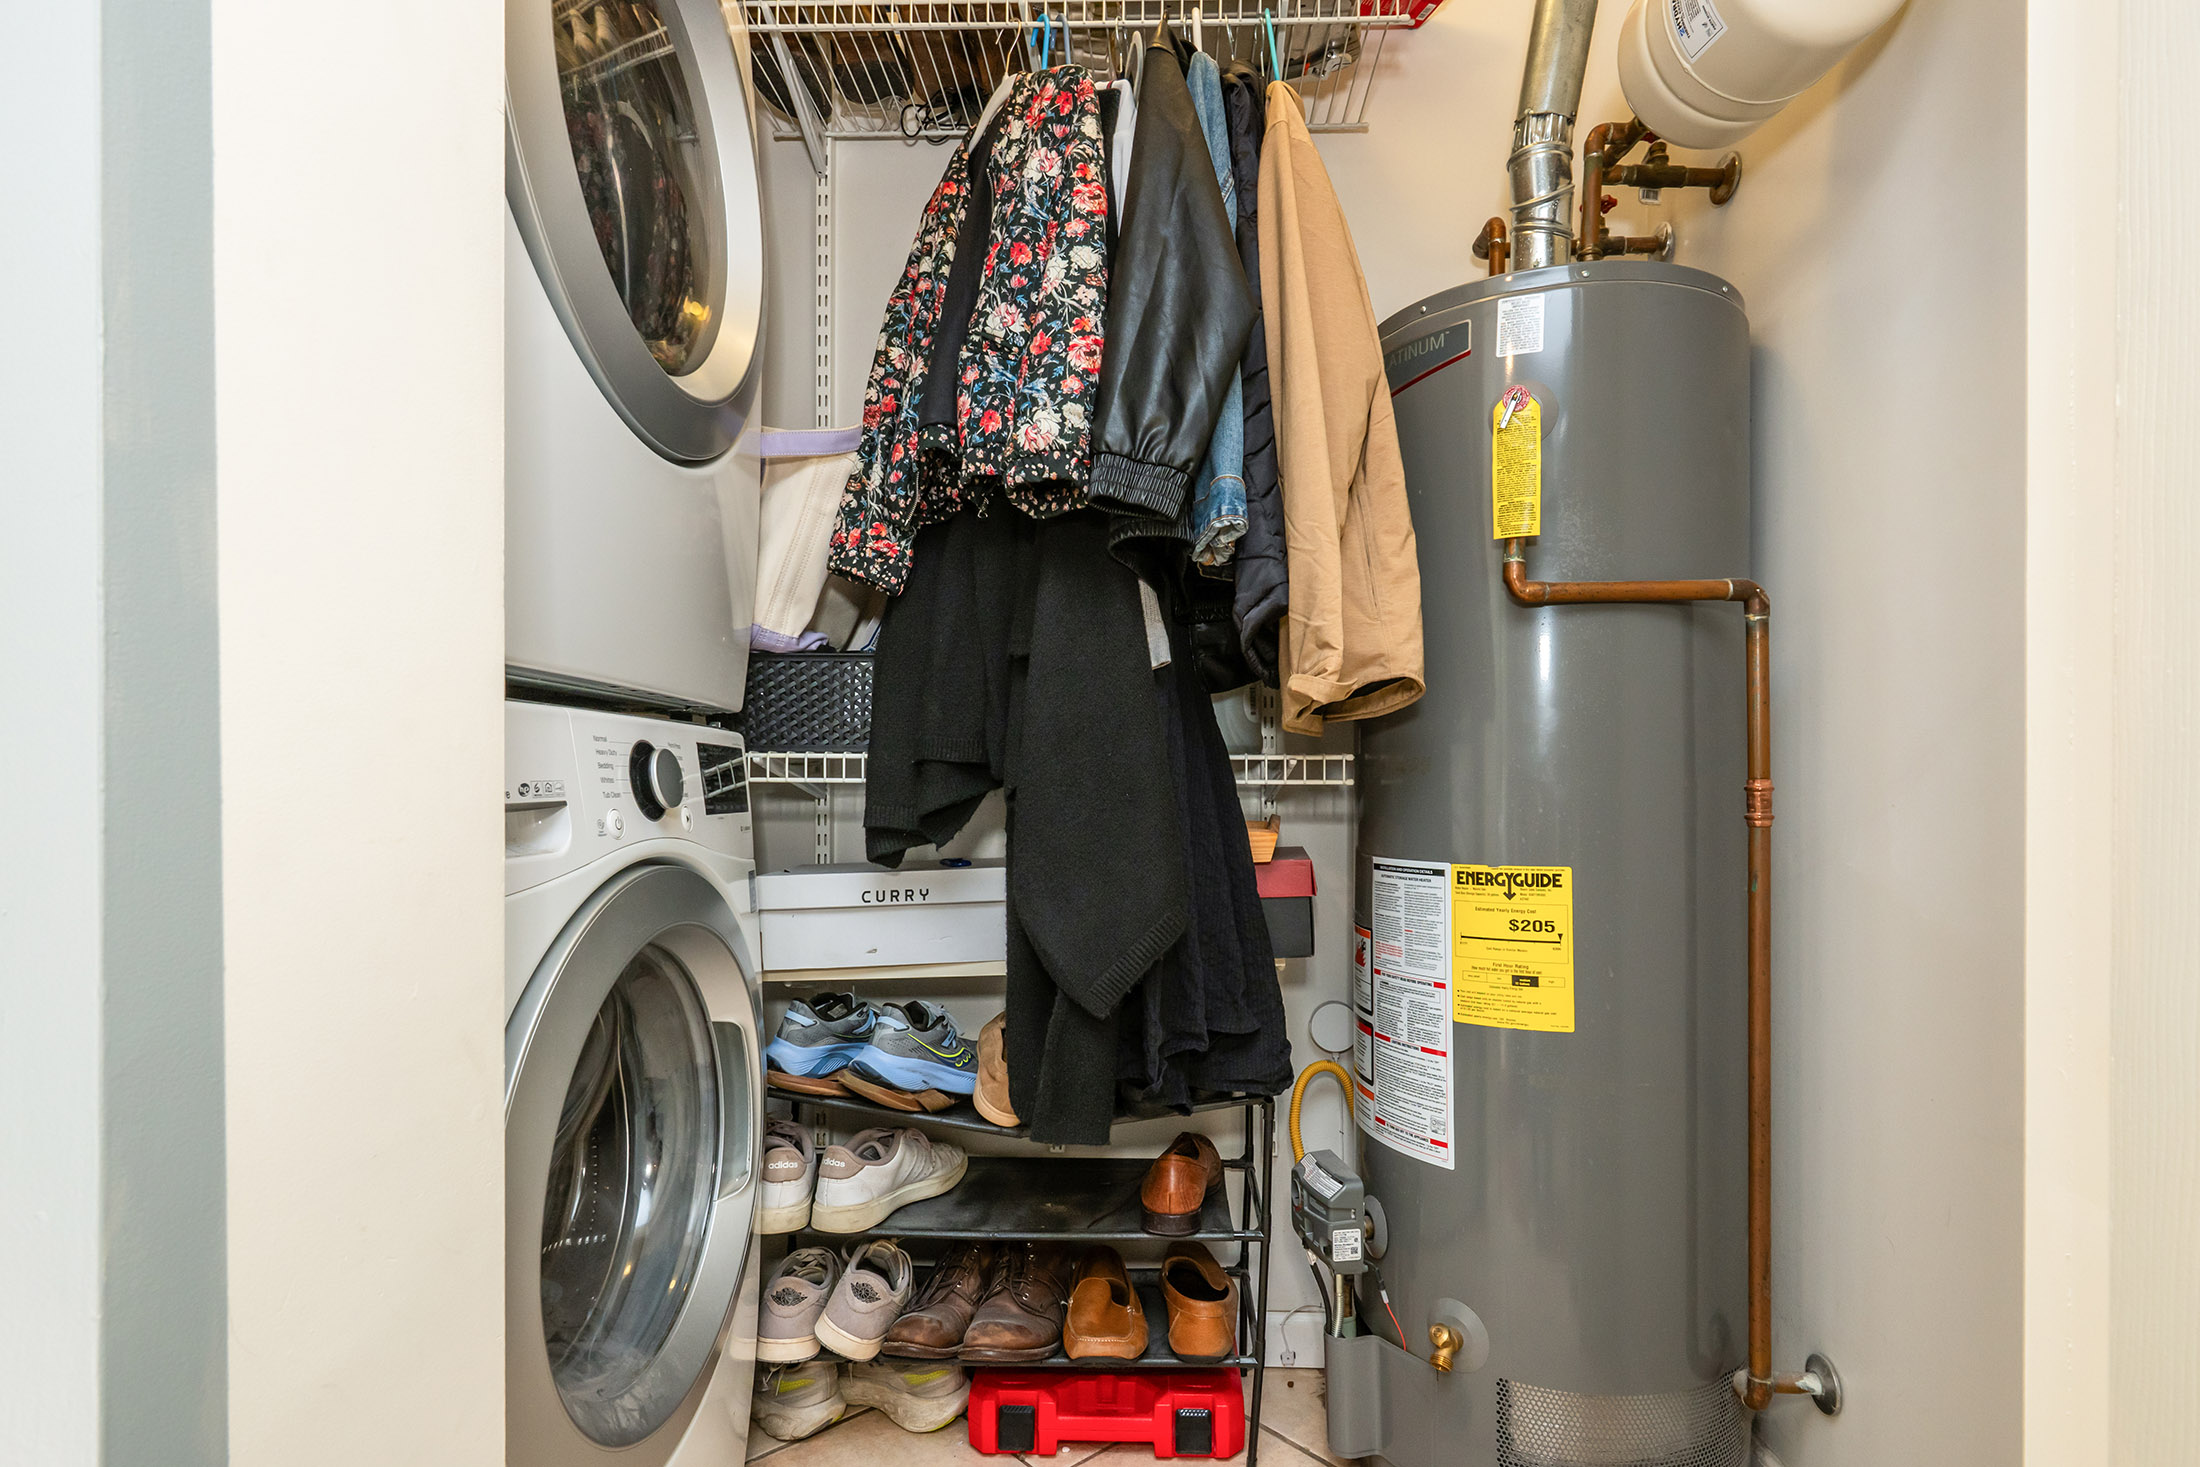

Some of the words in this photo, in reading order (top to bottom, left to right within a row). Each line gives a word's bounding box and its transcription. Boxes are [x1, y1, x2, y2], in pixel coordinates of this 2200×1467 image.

[1456, 871, 1563, 888] ENERGYGUIDE
[861, 888, 929, 903] CURRY
[1508, 918, 1555, 933] $205
[768, 1160, 798, 1170] adidas
